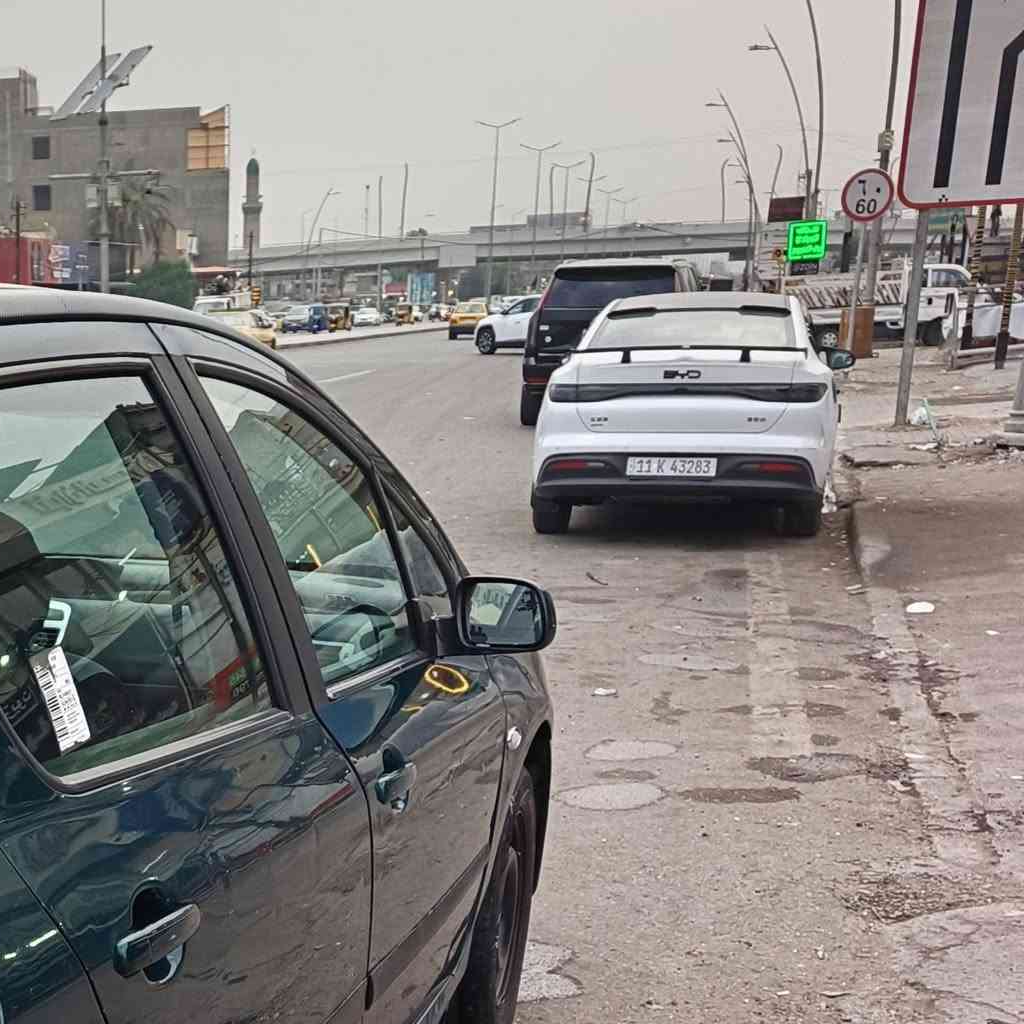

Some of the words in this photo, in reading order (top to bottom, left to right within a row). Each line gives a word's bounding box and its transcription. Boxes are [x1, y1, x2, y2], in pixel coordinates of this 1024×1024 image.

[856, 199, 877, 214] 60
[664, 370, 701, 379] BYD
[636, 459, 652, 473] 11
[656, 459, 666, 473] K
[670, 459, 712, 474] 43283
